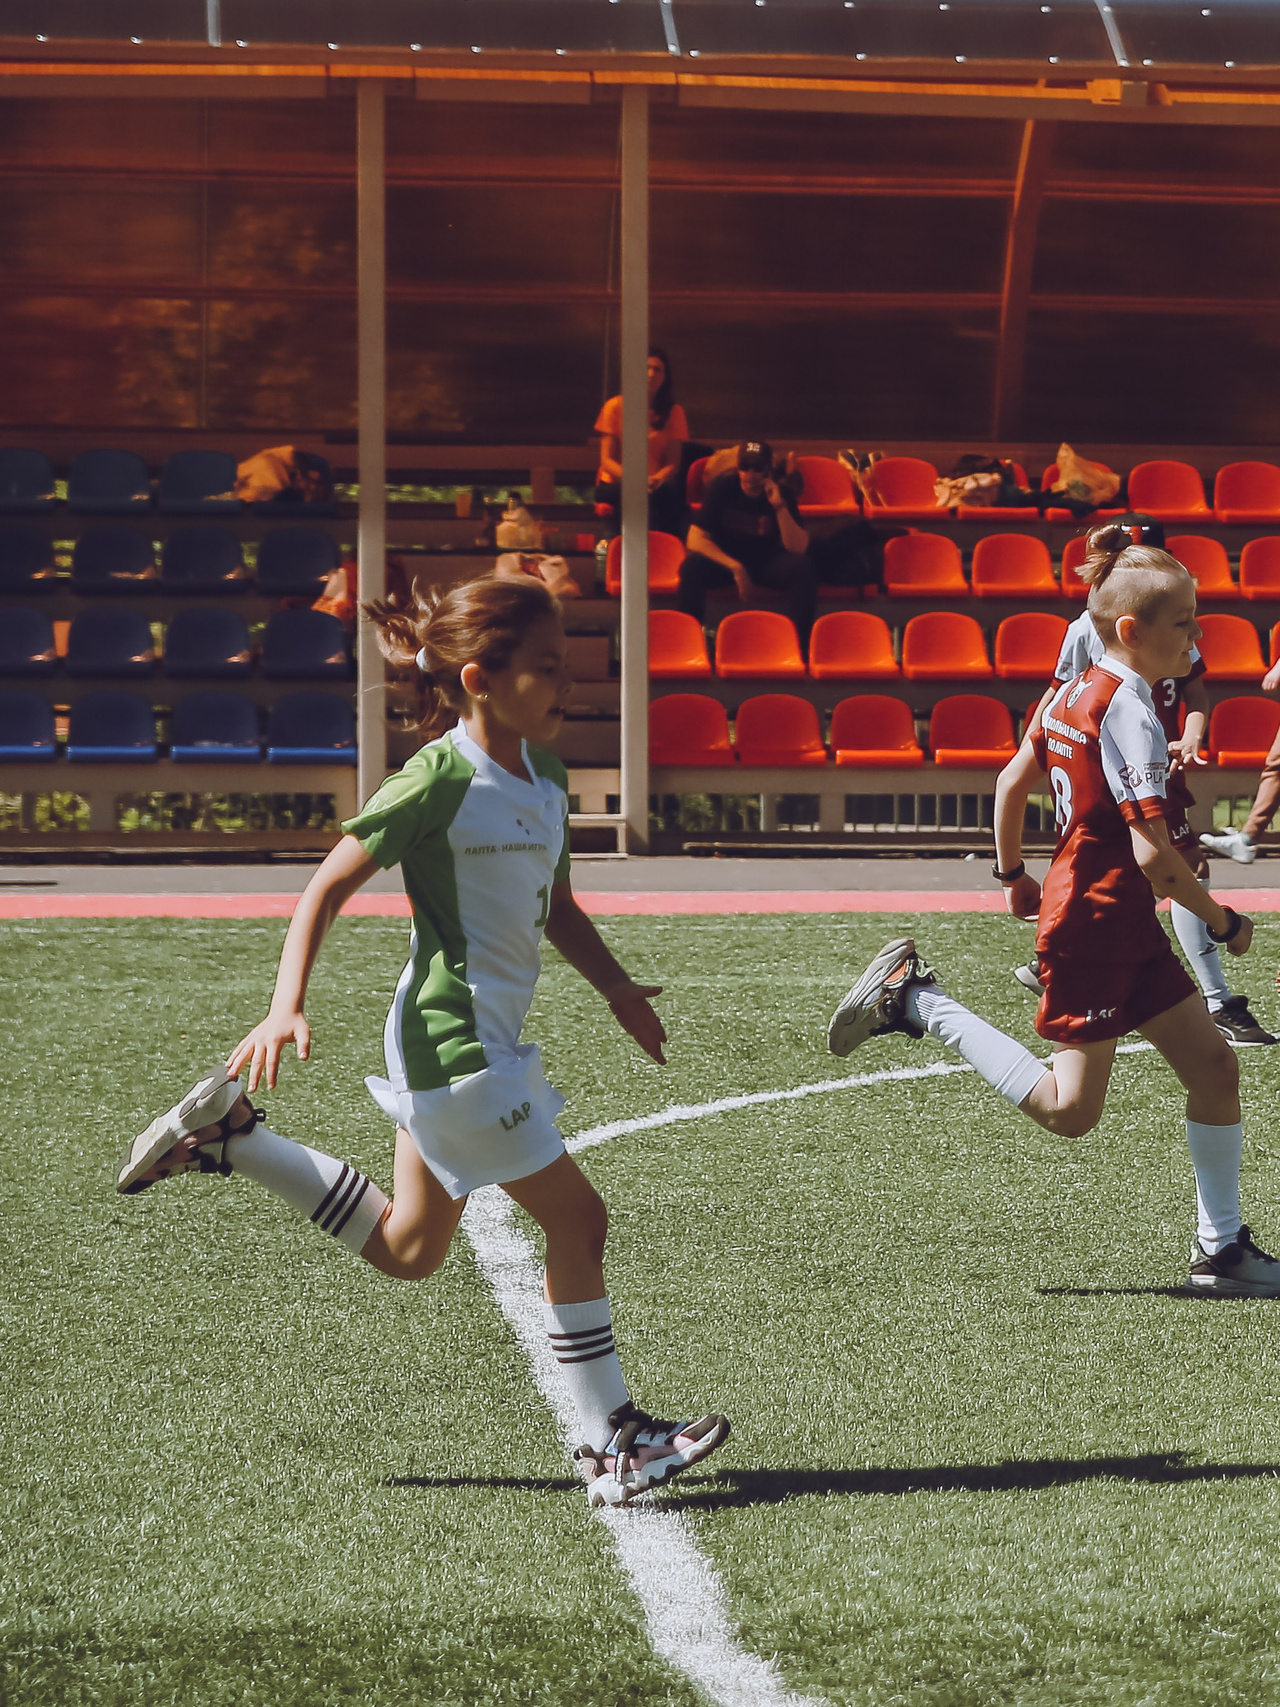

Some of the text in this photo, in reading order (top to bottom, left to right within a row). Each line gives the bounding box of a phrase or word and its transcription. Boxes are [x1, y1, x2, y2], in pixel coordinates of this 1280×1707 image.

[1163, 678, 1176, 707] 3
[534, 883, 549, 928] 1
[499, 1101, 531, 1131] LAP
